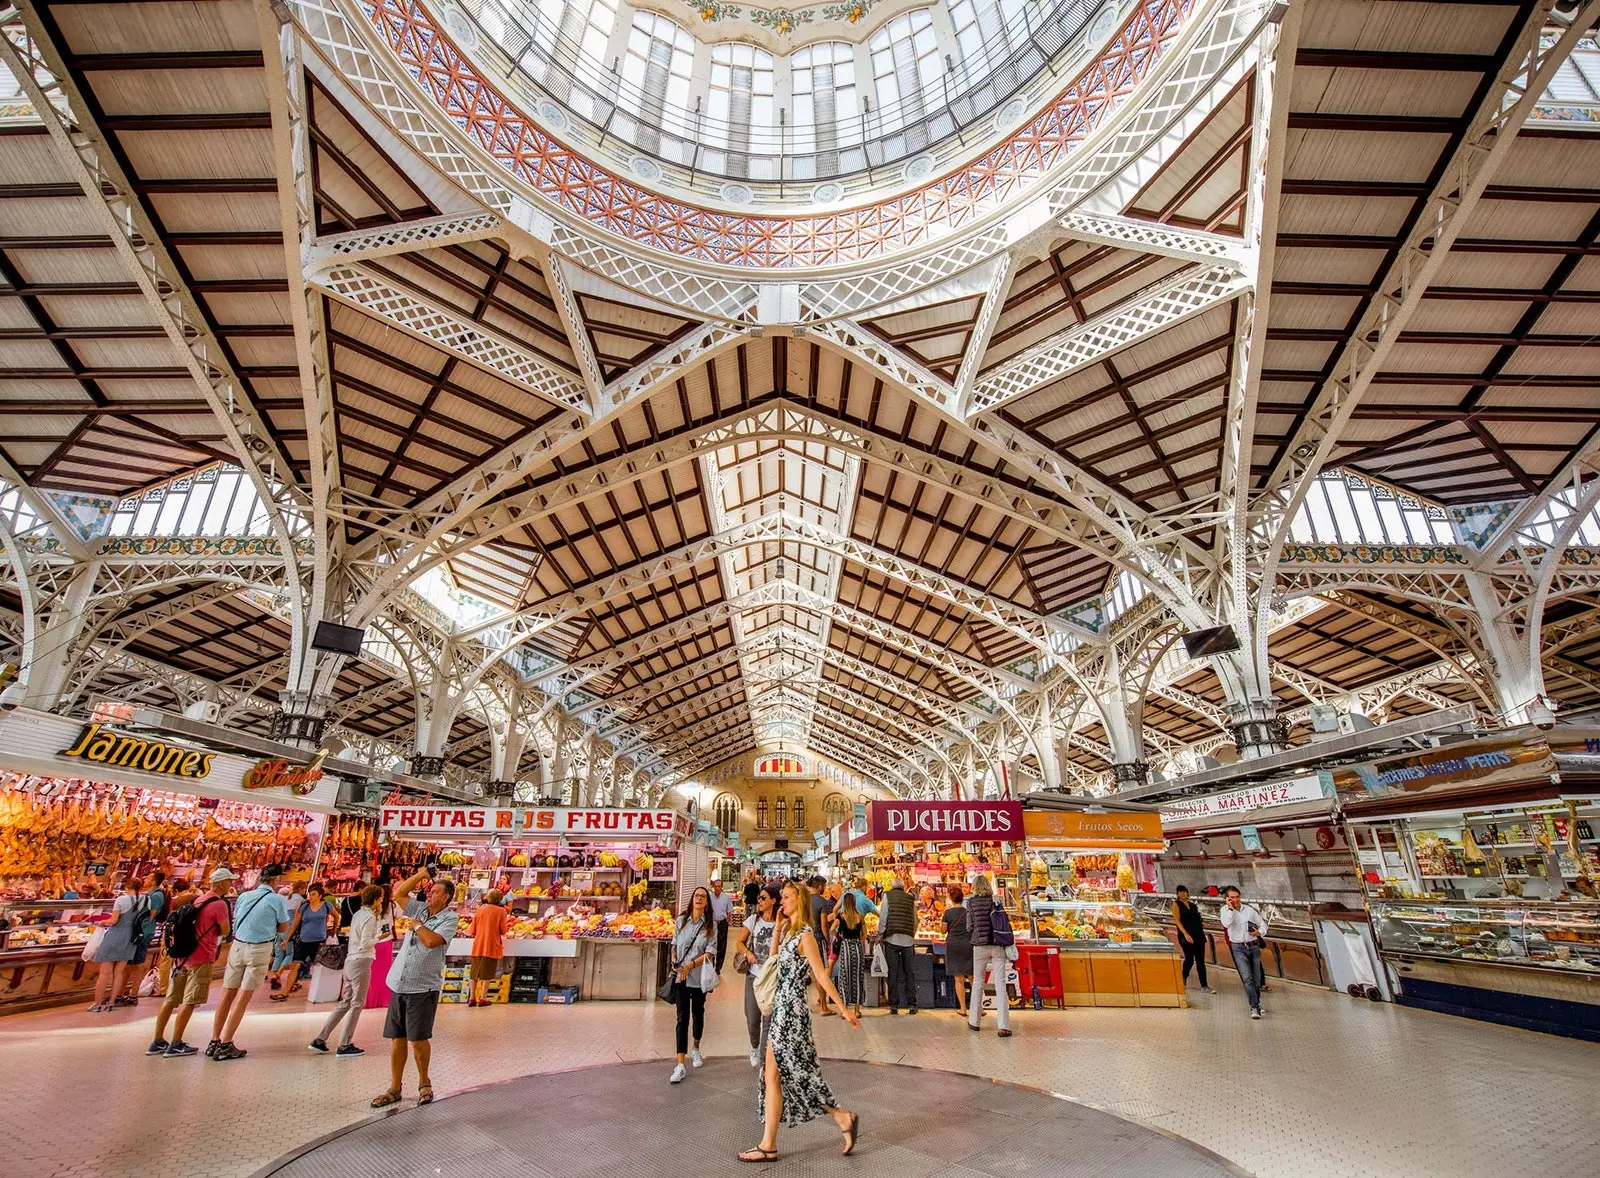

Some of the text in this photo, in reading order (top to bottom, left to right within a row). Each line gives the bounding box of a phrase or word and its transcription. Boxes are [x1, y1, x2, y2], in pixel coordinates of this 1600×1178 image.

[64, 722, 218, 779] Jamones
[1465, 749, 1511, 769] PERIS
[1177, 798, 1207, 808] SELECTAS
[1216, 790, 1250, 801] CONEJOS
[1261, 781, 1295, 792] HUEVOS
[1218, 788, 1289, 810] MARTINEZ
[1275, 795, 1308, 804] PERSONAL
[382, 809, 486, 828] FRUTAS
[567, 811, 674, 830] FRUTAS
[886, 809, 1012, 832] PUCHADES
[1078, 820, 1144, 832] Frutos Secos
